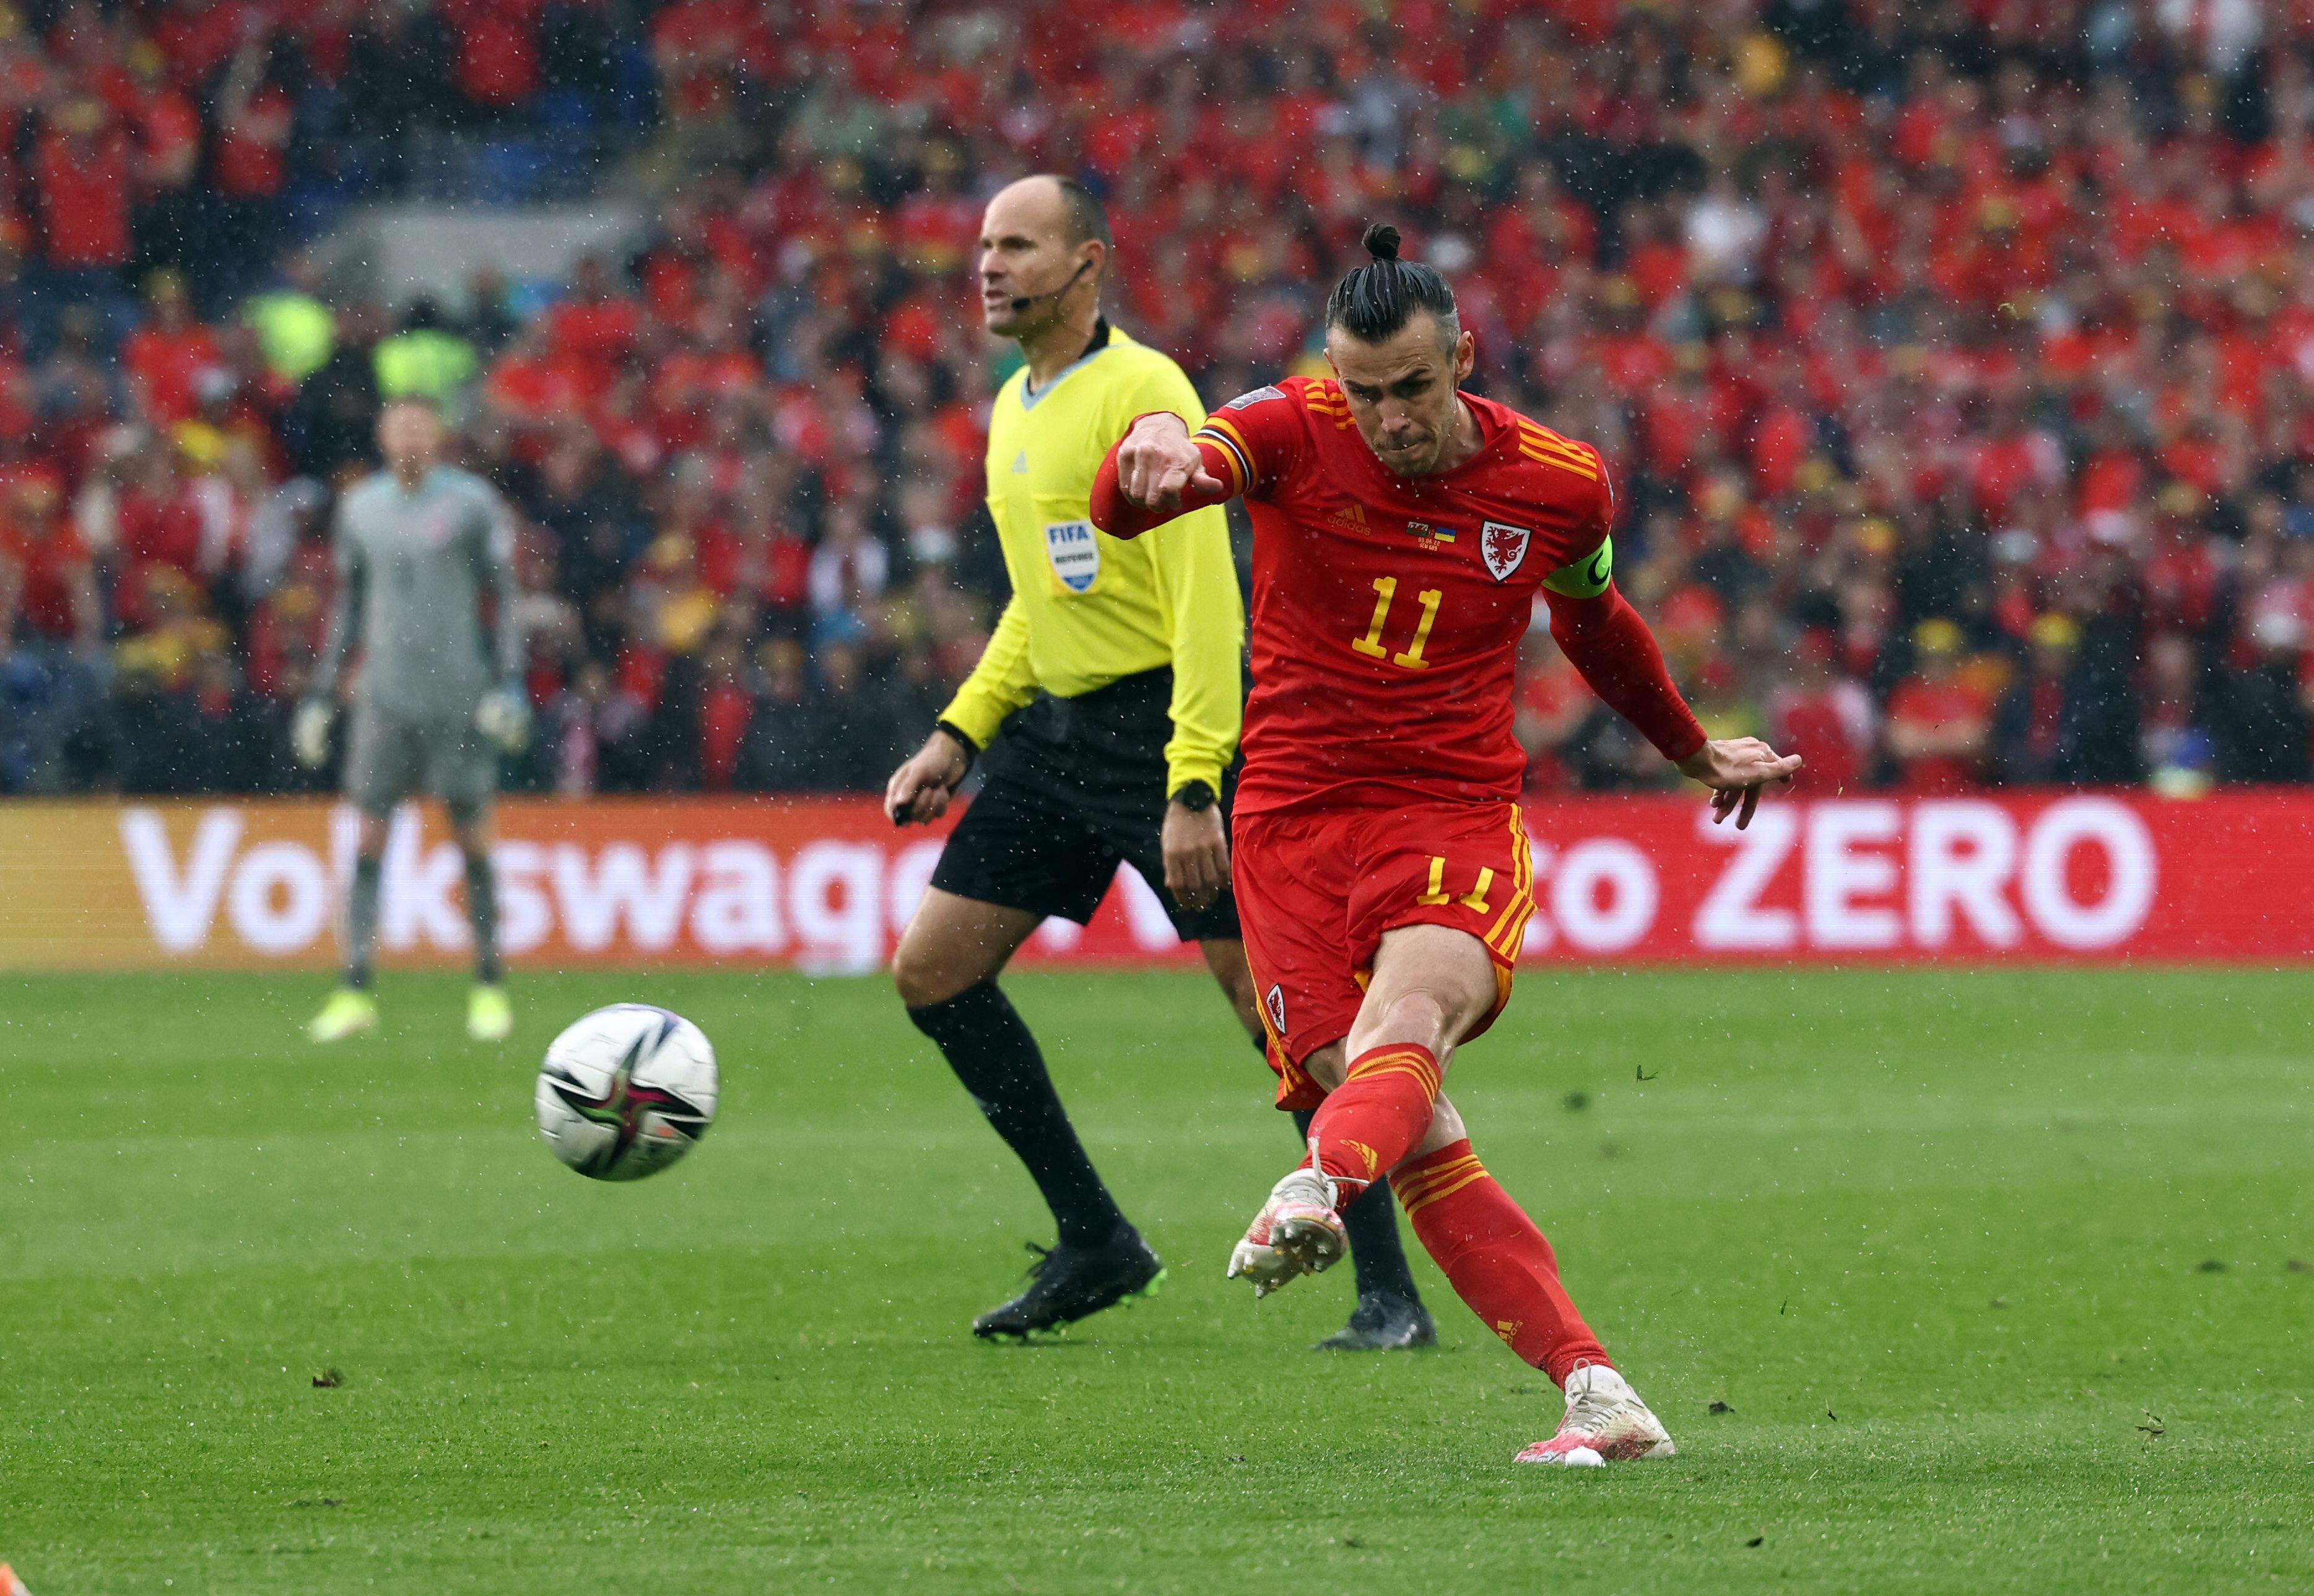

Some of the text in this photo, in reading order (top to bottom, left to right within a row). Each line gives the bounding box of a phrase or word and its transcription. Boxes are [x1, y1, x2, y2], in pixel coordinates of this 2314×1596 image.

[1049, 525, 1089, 545] FIFA
[1328, 516, 1372, 536] adidas
[1352, 576, 1442, 670] 11
[119, 804, 1084, 976] Volkswag
[1695, 796, 2159, 952] ZERO
[1417, 855, 1494, 914] 11
